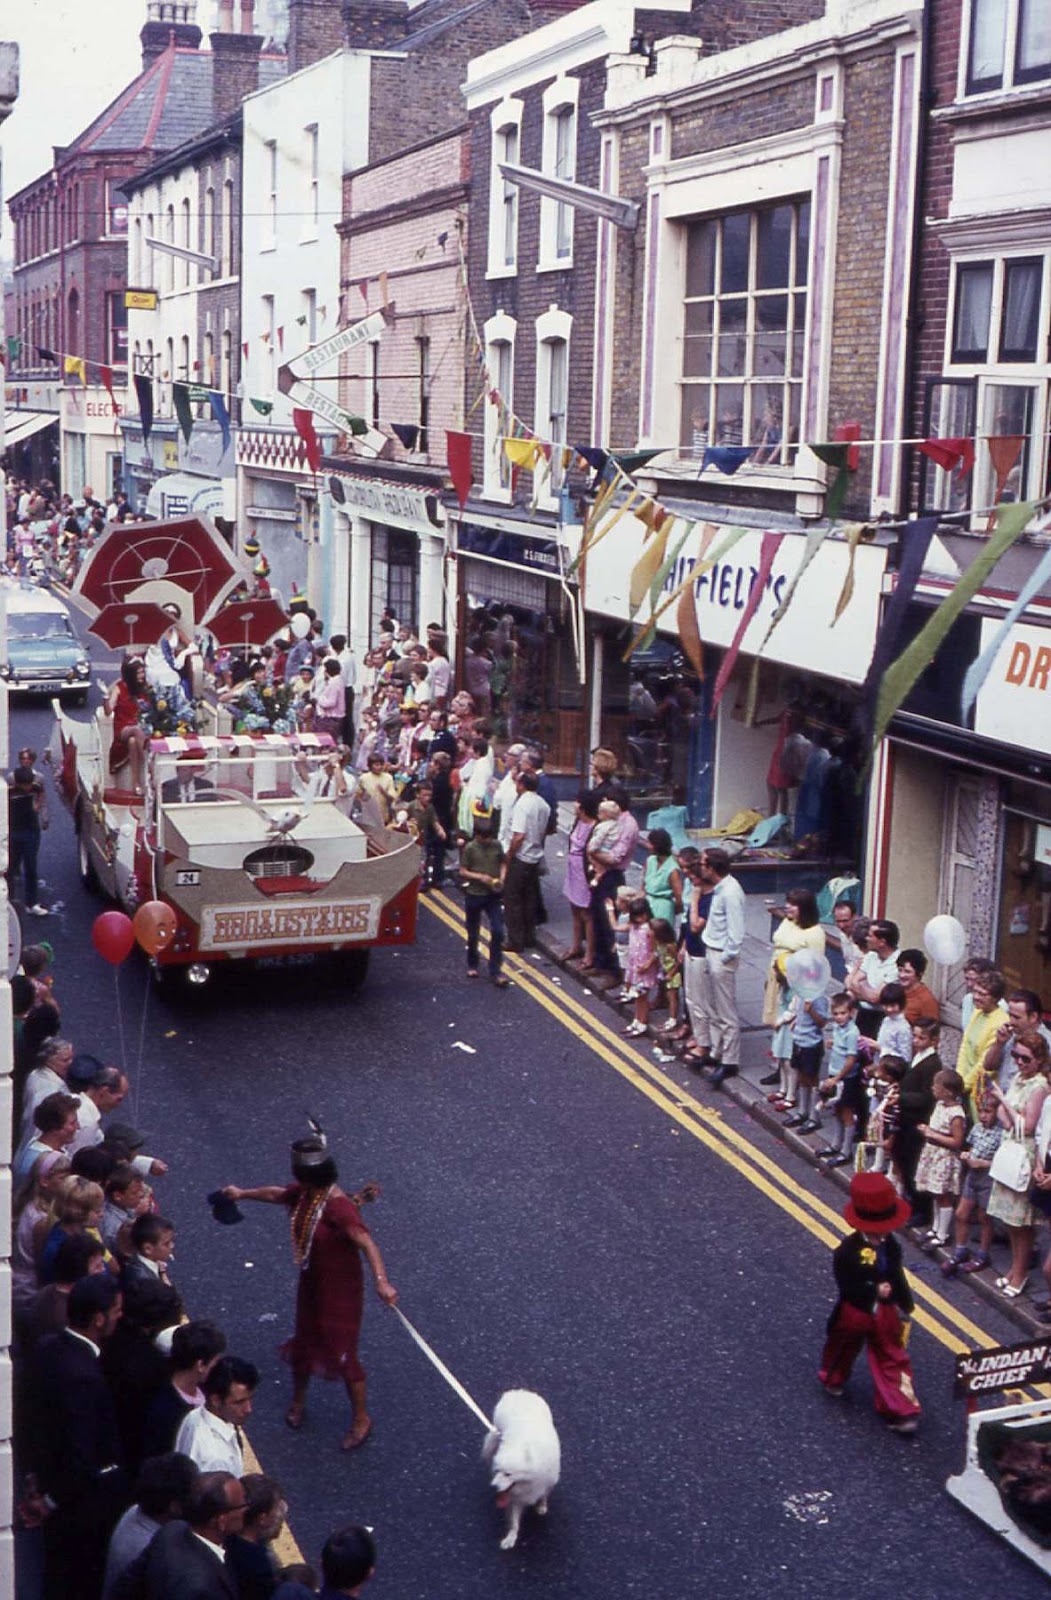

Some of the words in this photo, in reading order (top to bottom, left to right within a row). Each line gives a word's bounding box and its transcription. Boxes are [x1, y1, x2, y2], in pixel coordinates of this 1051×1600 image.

[303, 323, 370, 368] RESTAURANT
[651, 555, 788, 618] HITFIELD'S
[212, 904, 371, 943] BROADSTAIRS
[969, 1366, 1032, 1390] CHIEF
[978, 1346, 1047, 1373] INDIAN
